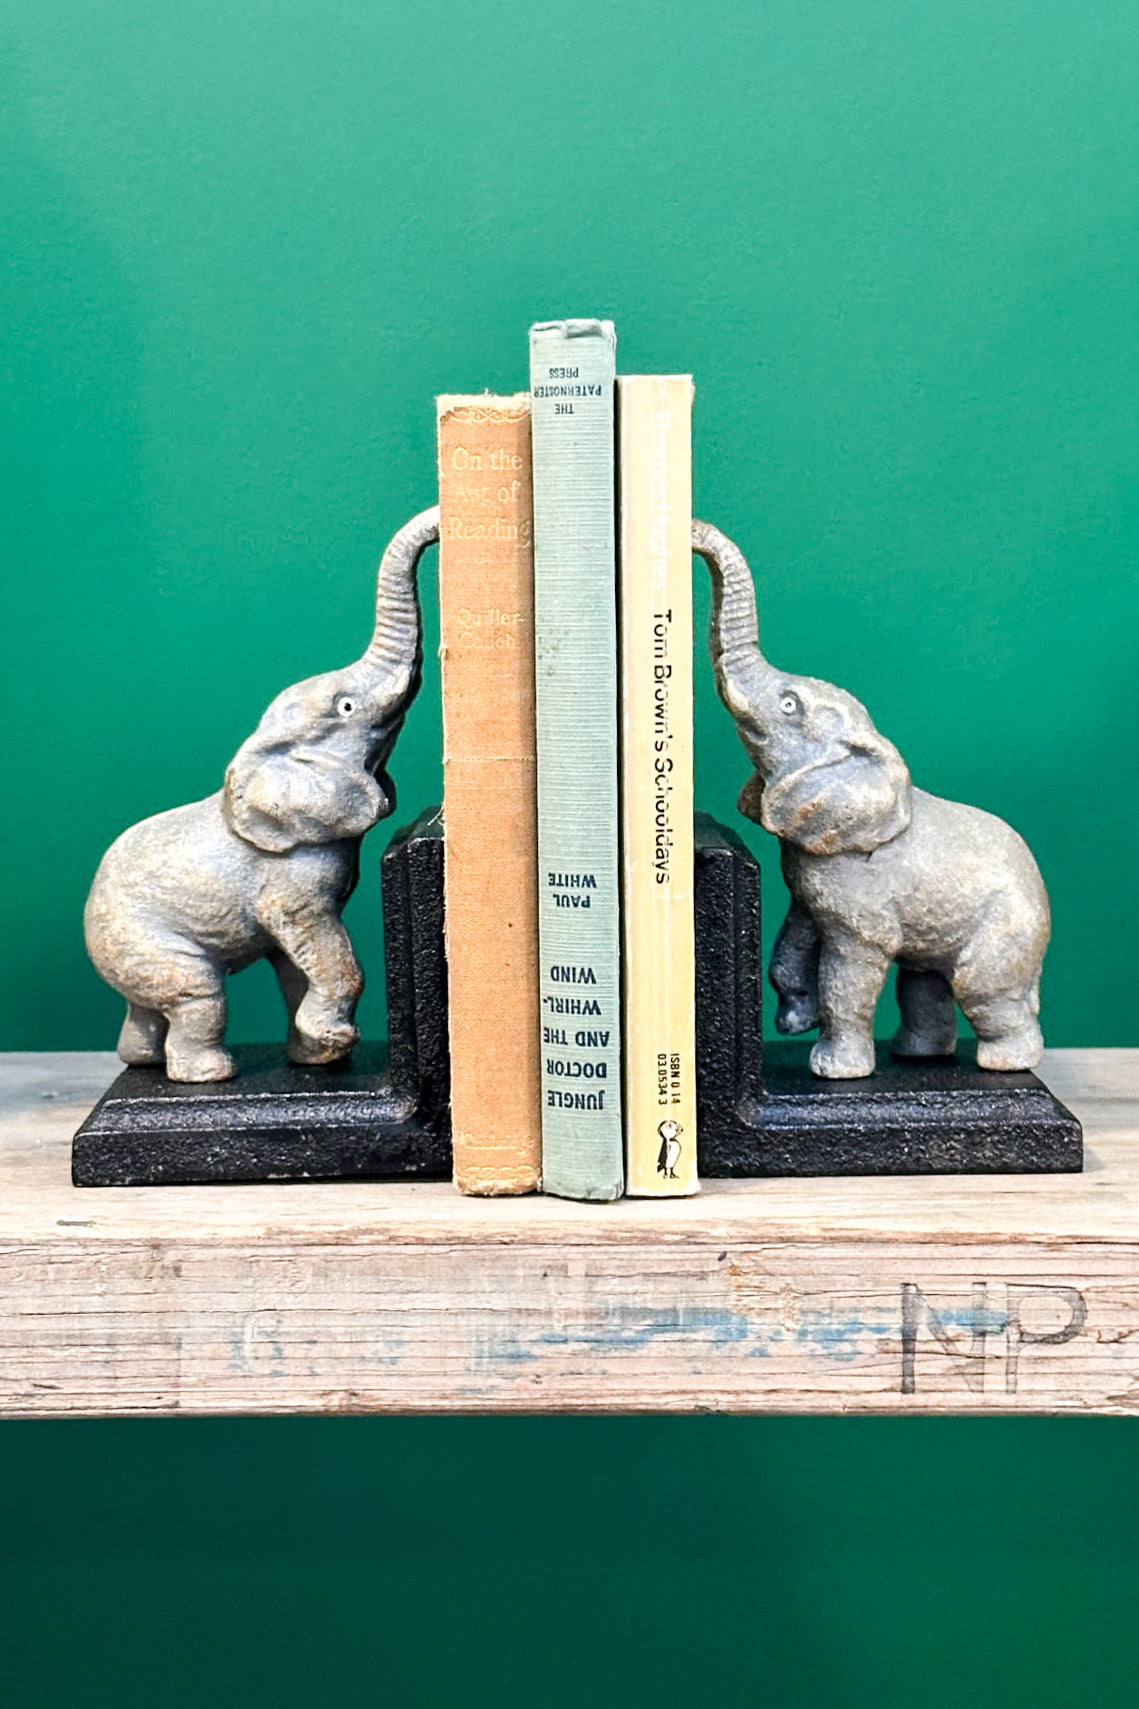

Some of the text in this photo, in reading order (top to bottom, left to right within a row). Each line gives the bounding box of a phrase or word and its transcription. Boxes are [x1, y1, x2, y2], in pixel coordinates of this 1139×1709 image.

[548, 366, 579, 379] PRESS
[533, 385, 602, 398] PATERNOSTER
[553, 403, 575, 415] THE
[452, 446, 523, 471] On the
[496, 479, 523, 503] of
[448, 516, 530, 549] Reading
[652, 609, 674, 885] Tom Brown's Schooldays
[548, 872, 597, 889] WHITE
[552, 893, 591, 909] PAUL
[550, 965, 597, 985] WIND
[542, 997, 601, 1016] WHIRL-
[543, 1027, 610, 1048] AND THE
[546, 1058, 608, 1079] DOCTOR
[670, 1052, 681, 1078] ISBN
[547, 1089, 606, 1111] JUNGLE
